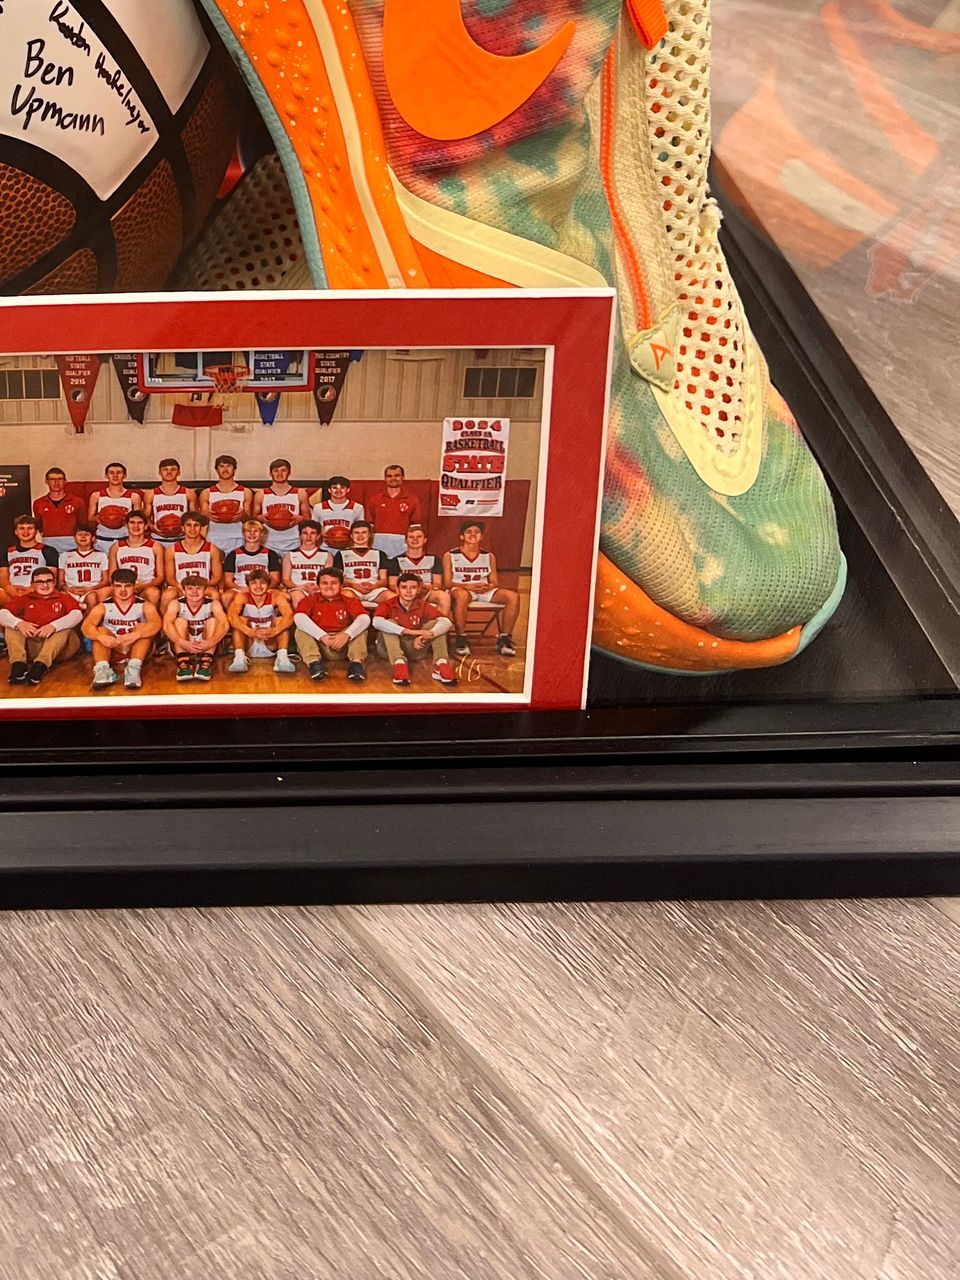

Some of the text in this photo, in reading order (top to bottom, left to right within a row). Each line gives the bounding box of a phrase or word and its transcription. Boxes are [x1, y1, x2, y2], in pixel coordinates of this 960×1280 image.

[24, 38, 74, 87] Ben
[11, 84, 105, 136] Upmann
[444, 438, 506, 455] BASKETBALL
[442, 454, 505, 474] STATE
[441, 473, 502, 491] QUALIFIER
[13, 565, 32, 577] 25
